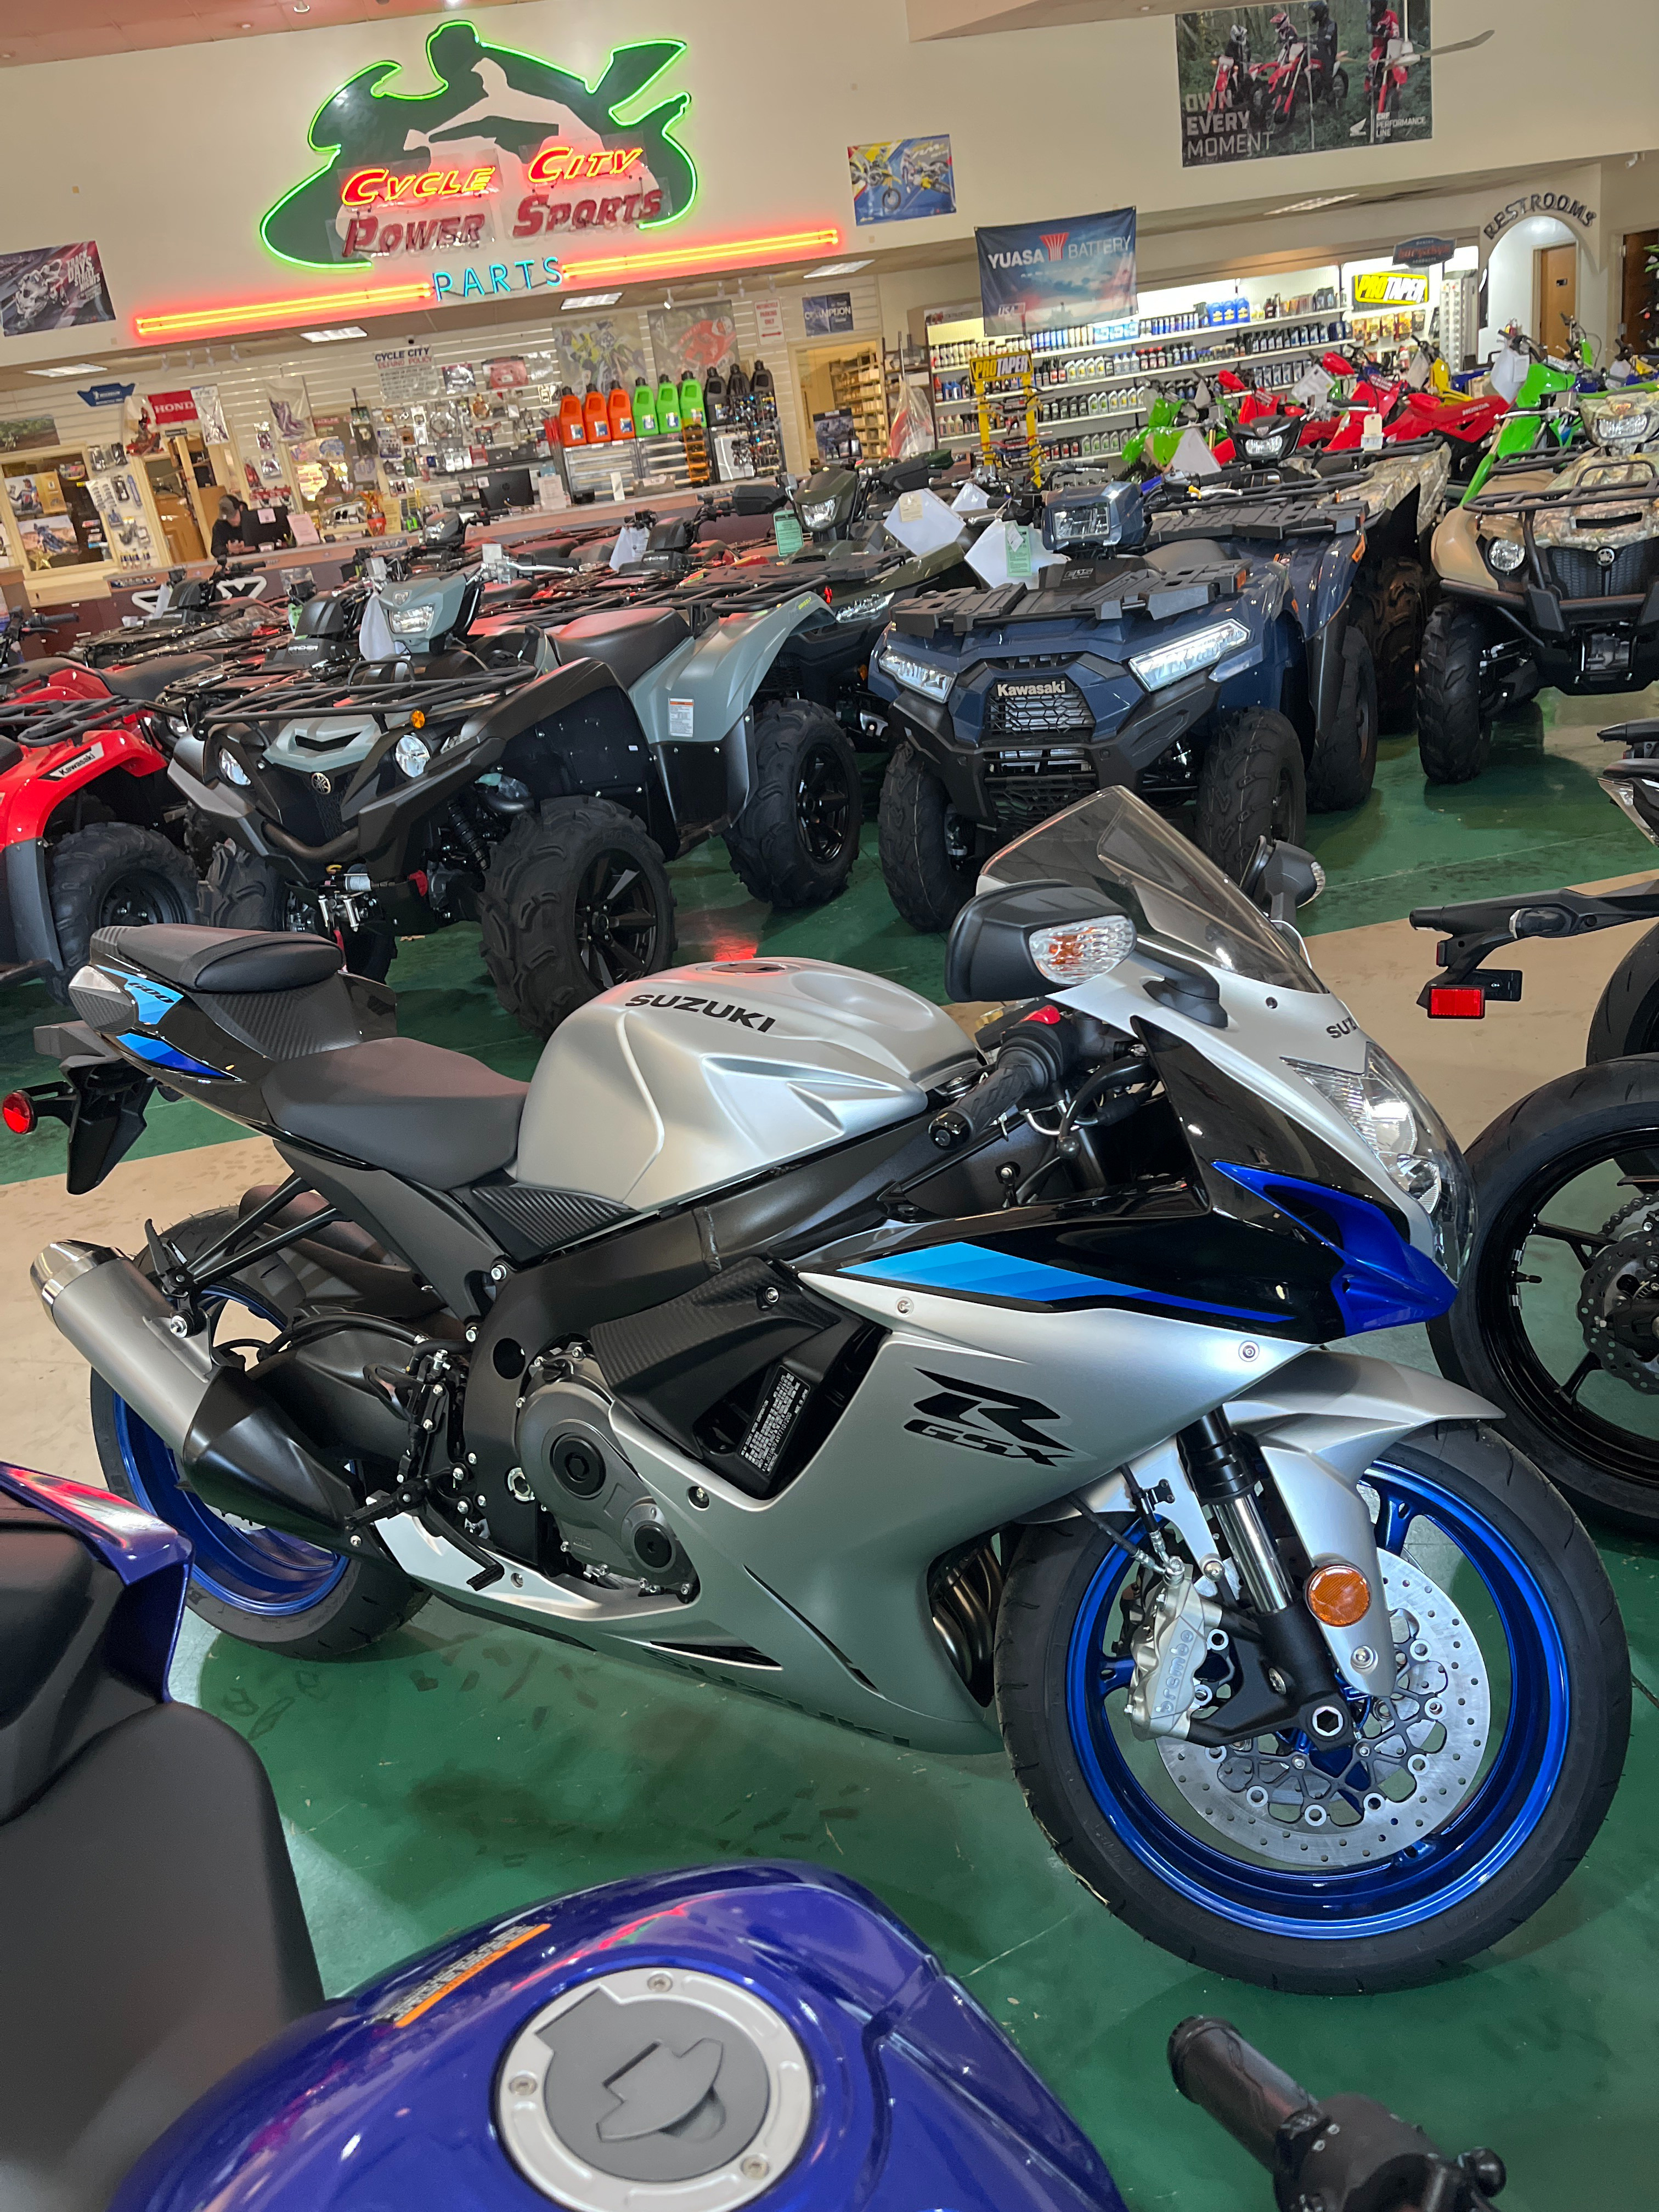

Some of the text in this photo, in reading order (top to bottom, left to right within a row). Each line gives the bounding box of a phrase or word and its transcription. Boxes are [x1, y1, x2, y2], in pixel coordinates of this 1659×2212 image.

[1187, 110, 1250, 136] EVERY
[1376, 116, 1426, 129] PERFORMANCE
[1376, 128, 1391, 137] LINE
[1187, 132, 1274, 159] MOMENT
[341, 146, 643, 206] CYCLE CITY
[342, 189, 663, 258] POWER SPORTS
[1483, 193, 1596, 239] RESTROOMS
[988, 235, 1131, 269] YUASA BATTERY
[432, 256, 563, 302] PARTS
[998, 305, 1015, 317] USA
[375, 347, 429, 362] CYCLE CITY
[154, 401, 196, 414] HOND
[1462, 403, 1490, 416] HONDA
[997, 680, 1065, 697] Kawasaki
[59, 752, 96, 775] Kawasaki
[625, 994, 776, 1032] SUZUKI
[1155, 1629, 1192, 1714] brembo
